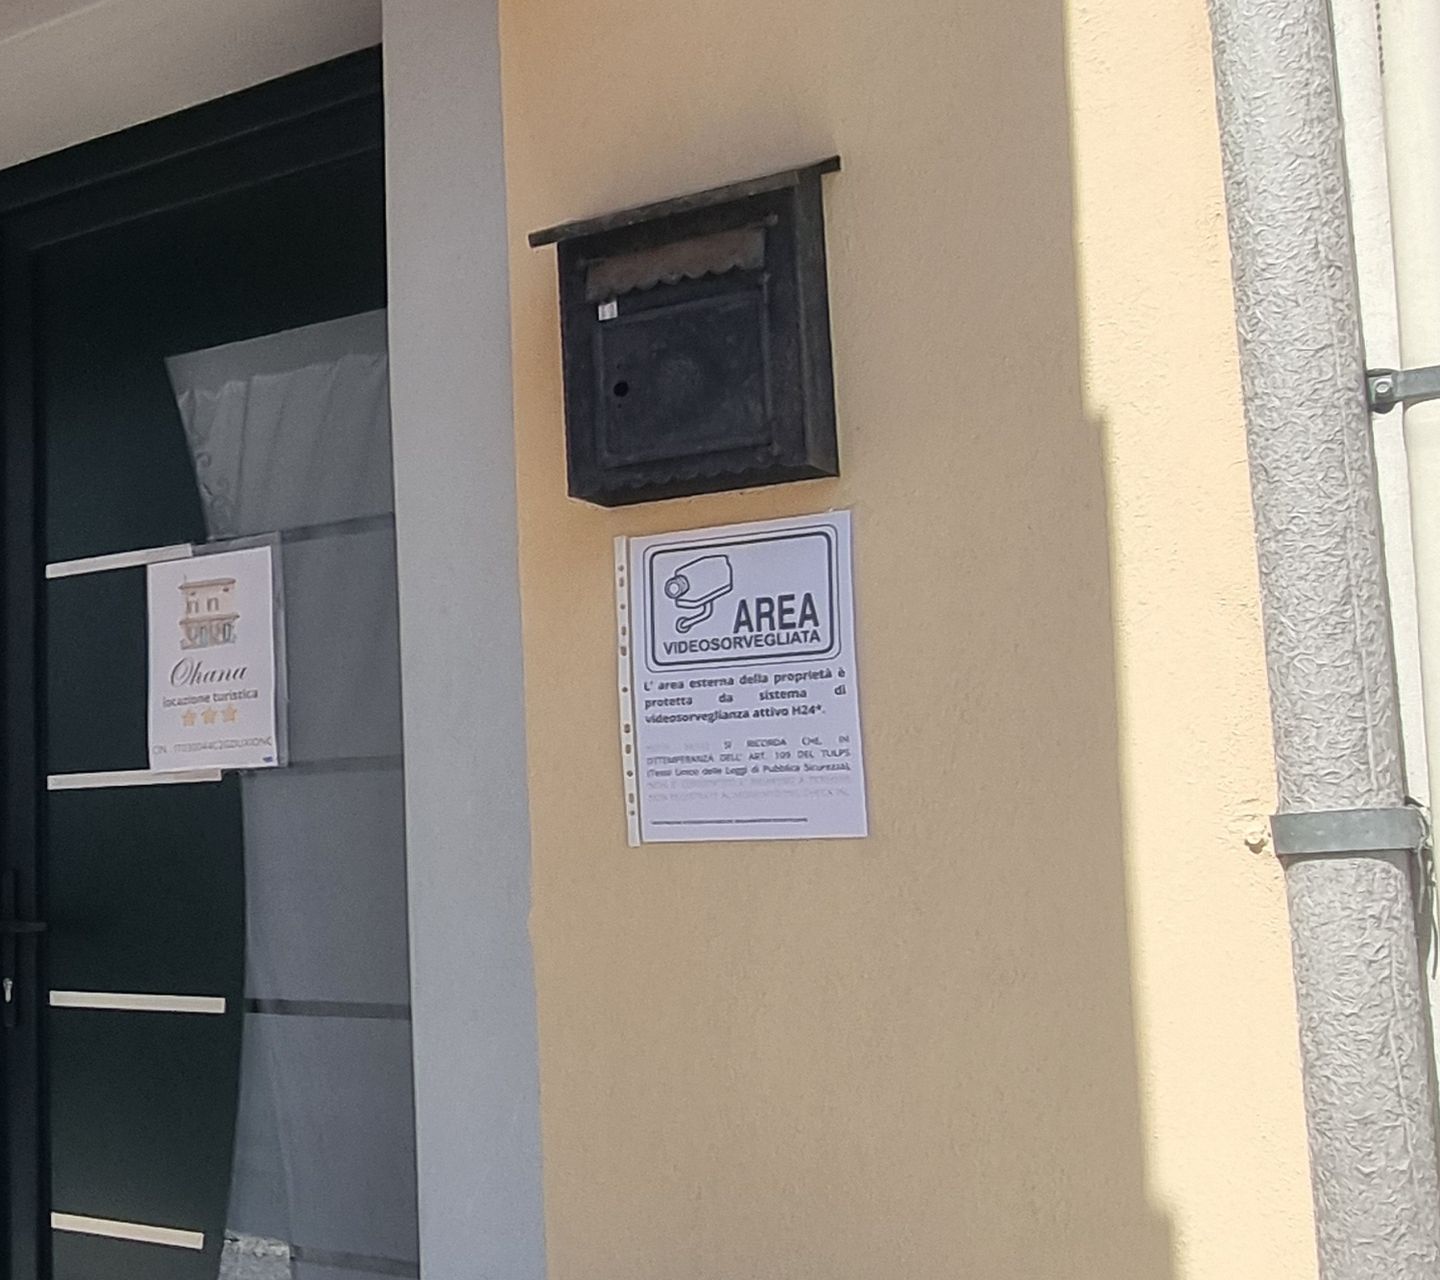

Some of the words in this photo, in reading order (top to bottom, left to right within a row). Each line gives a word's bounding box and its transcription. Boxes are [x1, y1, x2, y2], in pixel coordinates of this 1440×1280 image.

[733, 592, 820, 634] AREA
[663, 629, 821, 656] VIDEOSORVEGLIATA
[170, 656, 248, 688] Ohana
[657, 681, 684, 690] area
[689, 677, 734, 688] esterna
[739, 673, 768, 685] della
[773, 668, 832, 685] proprietà
[212, 688, 259, 703] turistica
[644, 697, 693, 710] protetta
[718, 693, 734, 703] da
[759, 689, 807, 701] sistema
[834, 684, 847, 696] di
[644, 709, 750, 724] videosorveglianza
[752, 706, 790, 718] attivo
